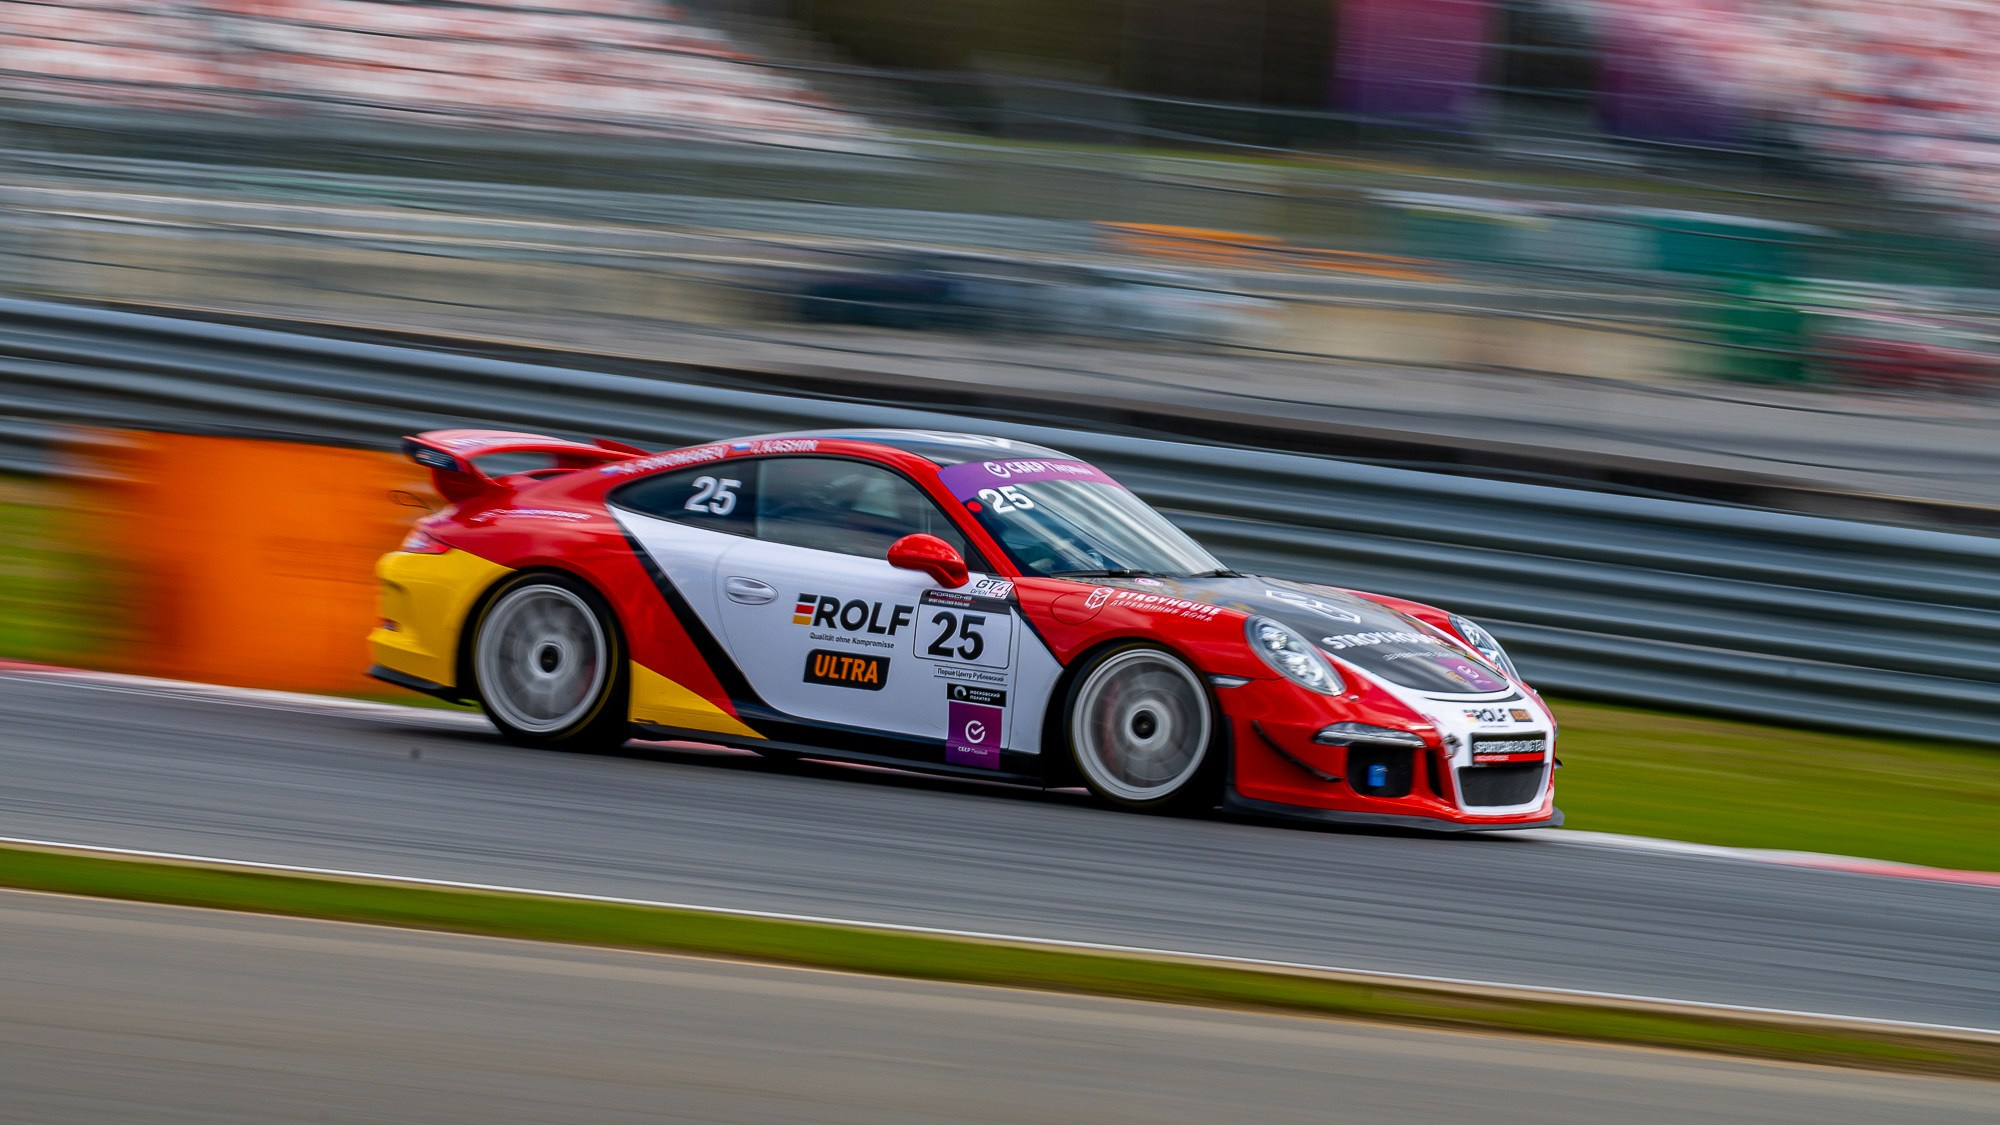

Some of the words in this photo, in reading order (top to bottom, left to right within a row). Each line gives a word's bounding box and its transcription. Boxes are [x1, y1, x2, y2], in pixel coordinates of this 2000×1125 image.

[684, 475, 742, 516] 25
[977, 485, 1035, 514] 25
[930, 591, 973, 601] PORSCHE
[1117, 591, 1223, 615] STROYHOUSE
[812, 595, 914, 636] ROLF
[835, 635, 851, 644] ohne
[852, 637, 895, 649] Kompromisse
[928, 610, 986, 661] 25
[1321, 631, 1446, 650] STROYHOU
[814, 654, 878, 684] ULTRA
[937, 667, 955, 677] Порше
[955, 671, 973, 681] Центр
